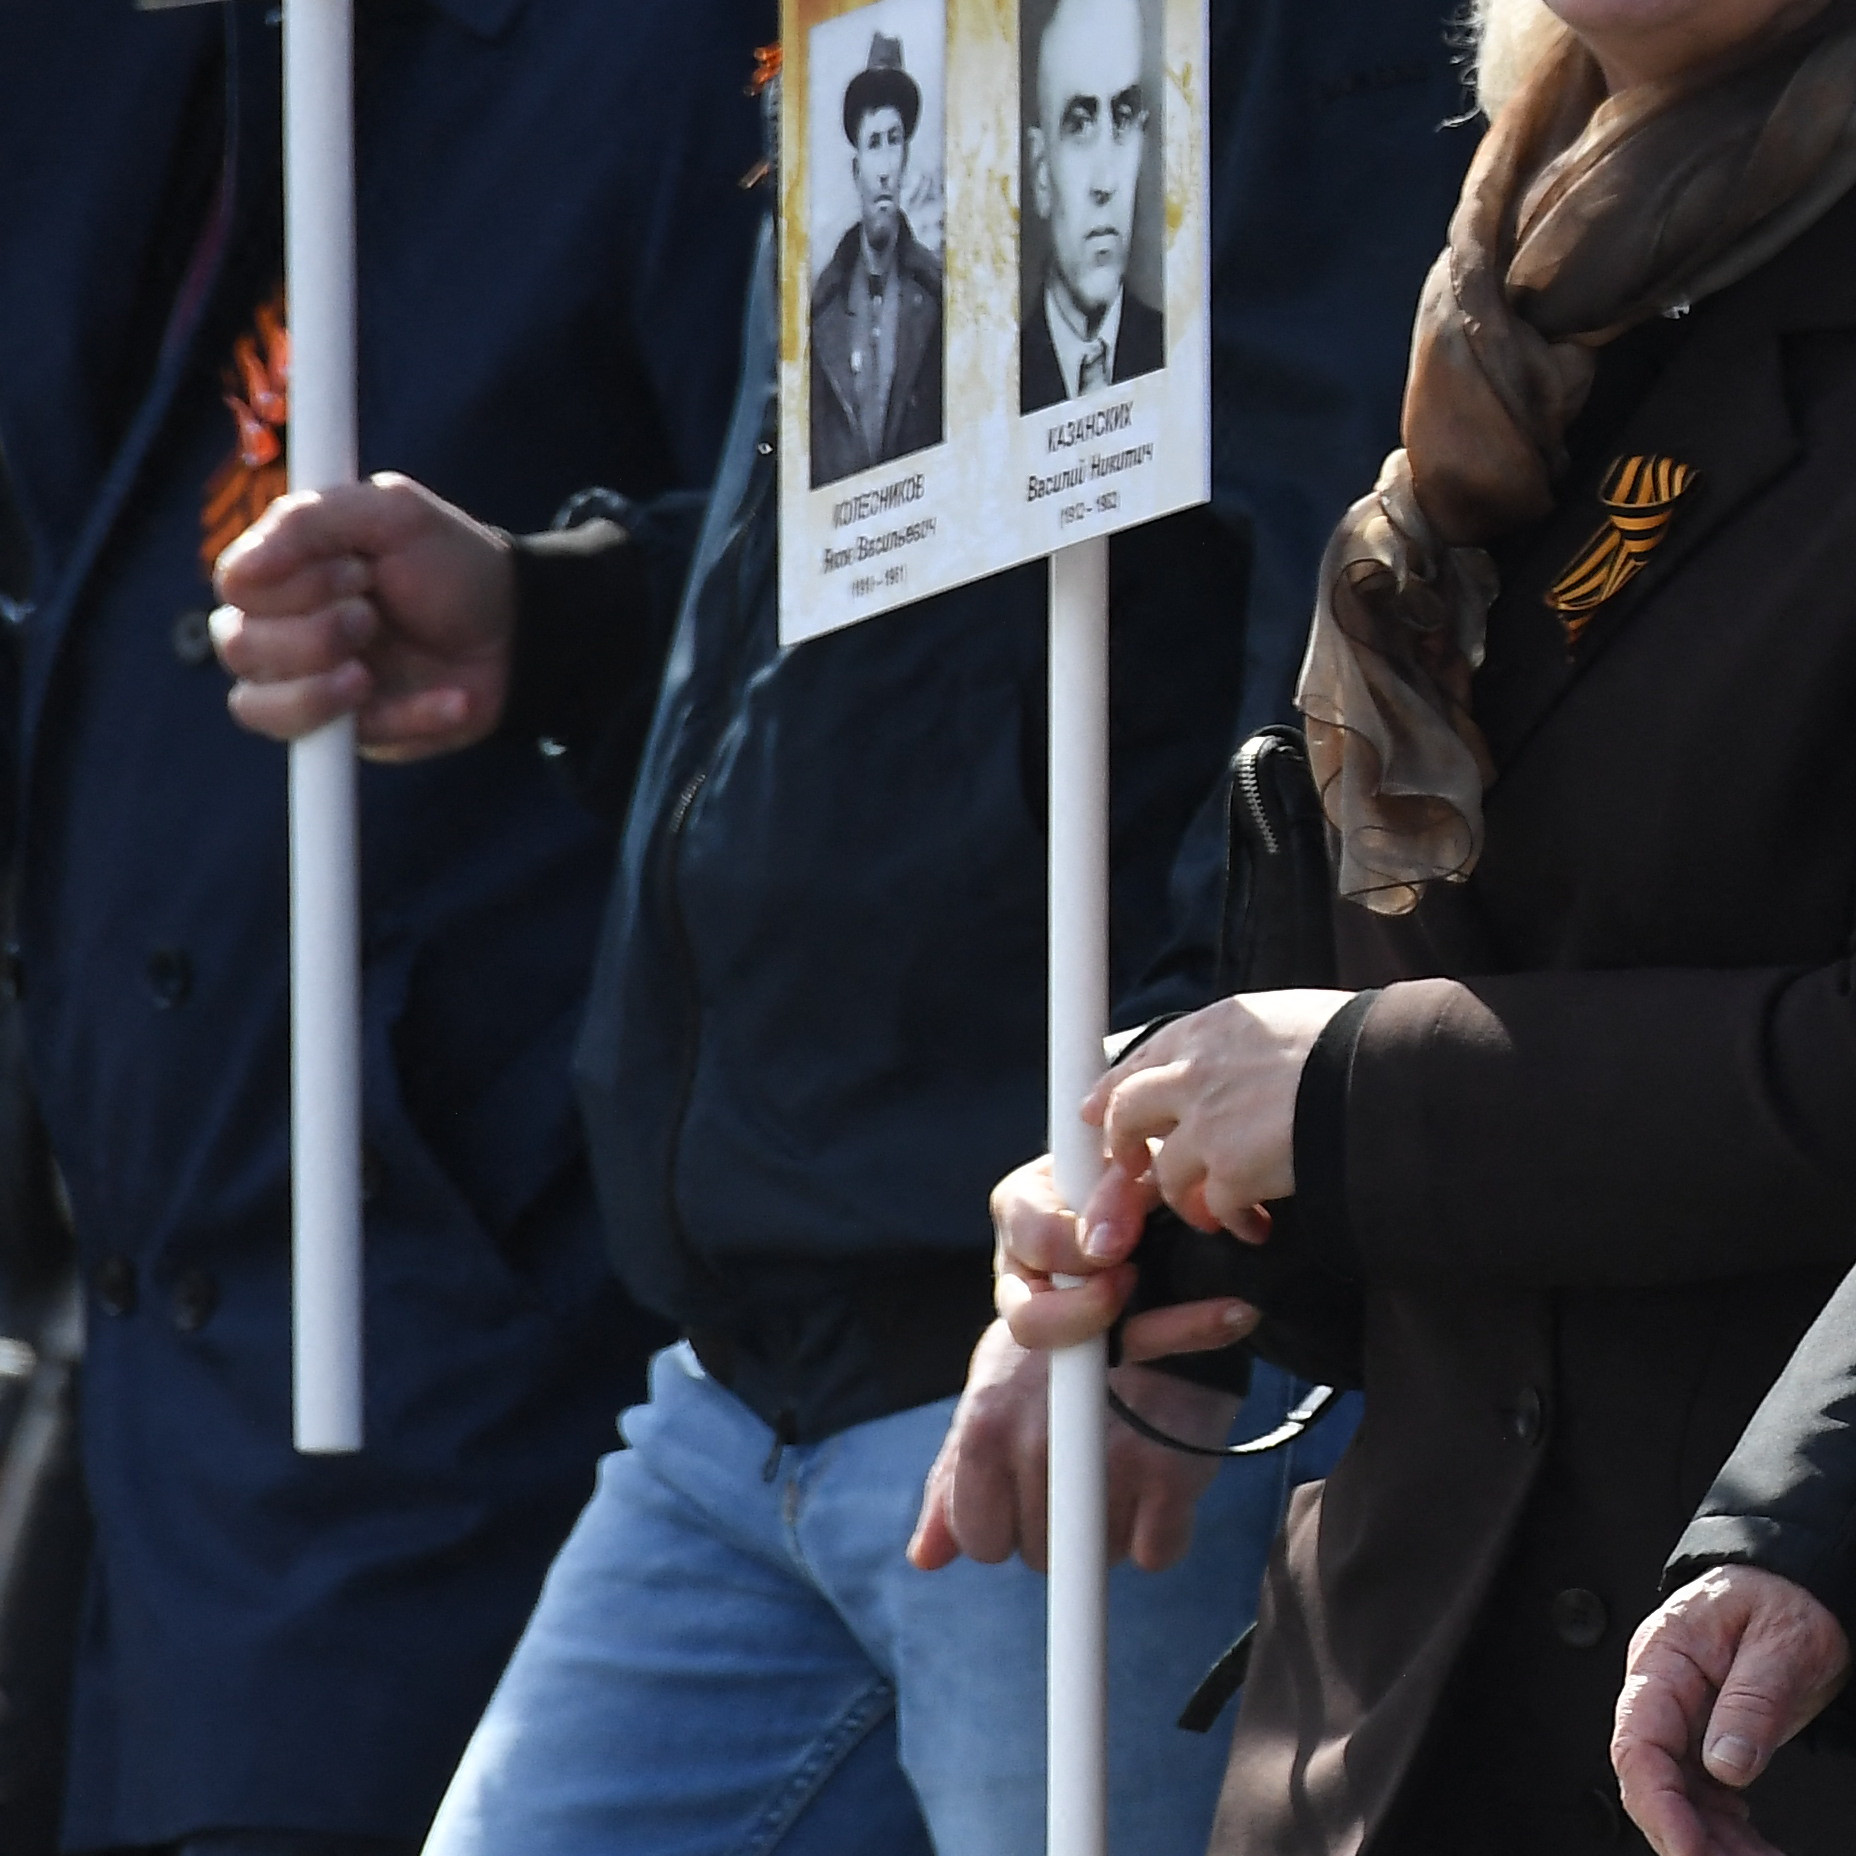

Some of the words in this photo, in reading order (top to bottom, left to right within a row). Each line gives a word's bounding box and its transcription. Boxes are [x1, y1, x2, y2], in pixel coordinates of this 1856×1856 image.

[1047, 401, 1133, 453] КАЗАНСКИХ
[1026, 457, 1085, 502] Василий
[1091, 442, 1154, 481] Никитич
[833, 472, 925, 529] КОЛЕСНИКОВ
[857, 516, 937, 562] Васильевич
